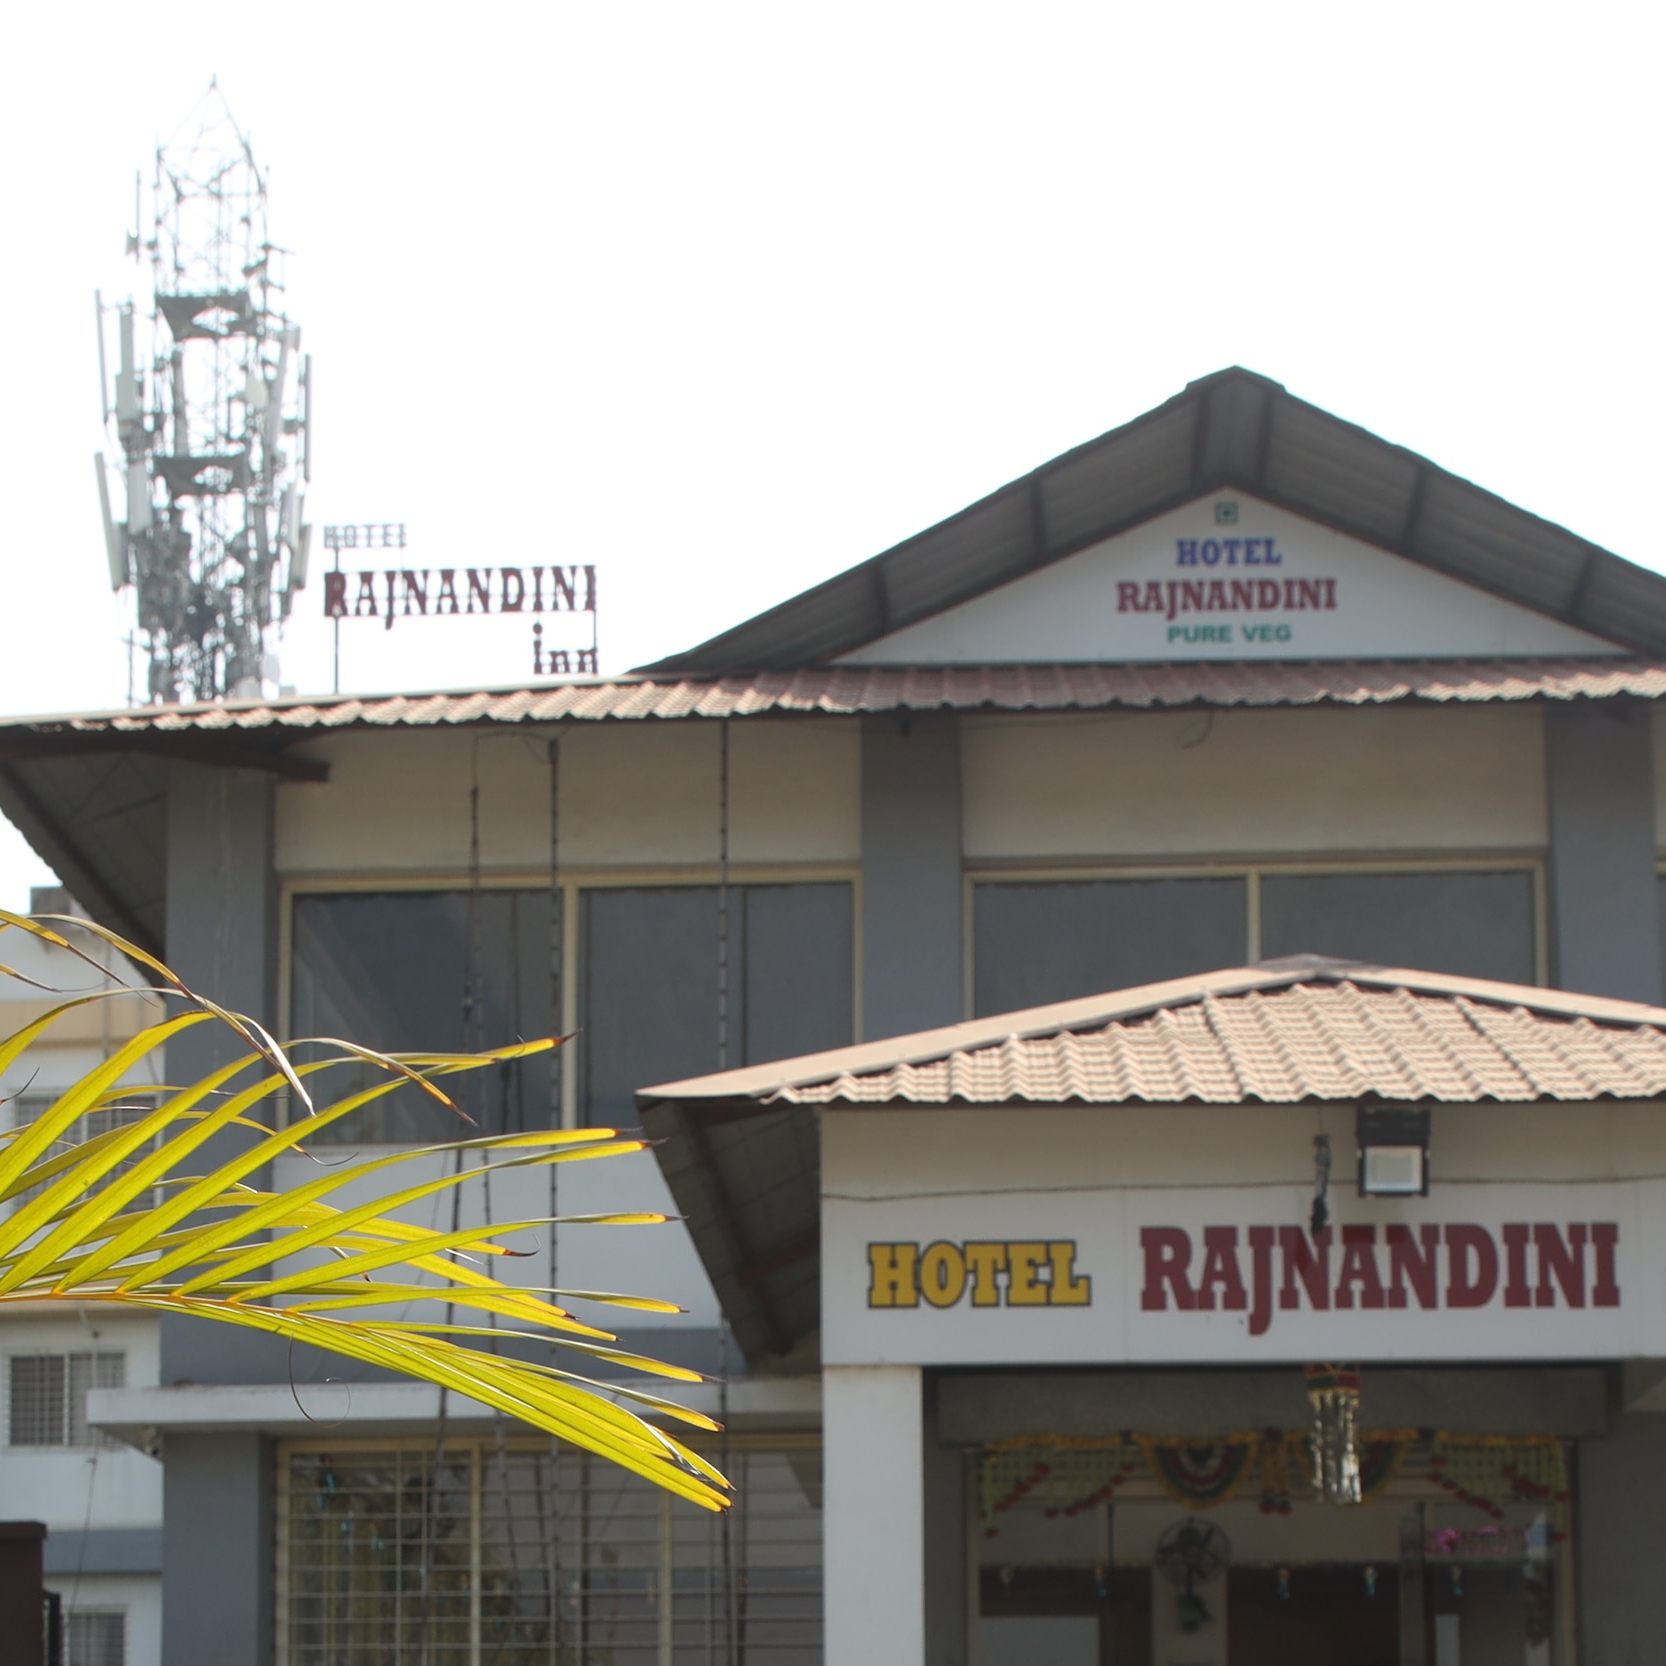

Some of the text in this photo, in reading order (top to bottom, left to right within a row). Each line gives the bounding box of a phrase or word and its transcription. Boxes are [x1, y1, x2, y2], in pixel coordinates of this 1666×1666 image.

[1176, 538, 1282, 567] HOTEL
[324, 565, 596, 630] RAJNANDINI
[1117, 578, 1338, 621] RAJNANDINI
[1167, 624, 1293, 643] PURE VEG
[866, 1239, 1092, 1308] HOTEL
[1139, 1222, 1621, 1335] RAJNANDINI
